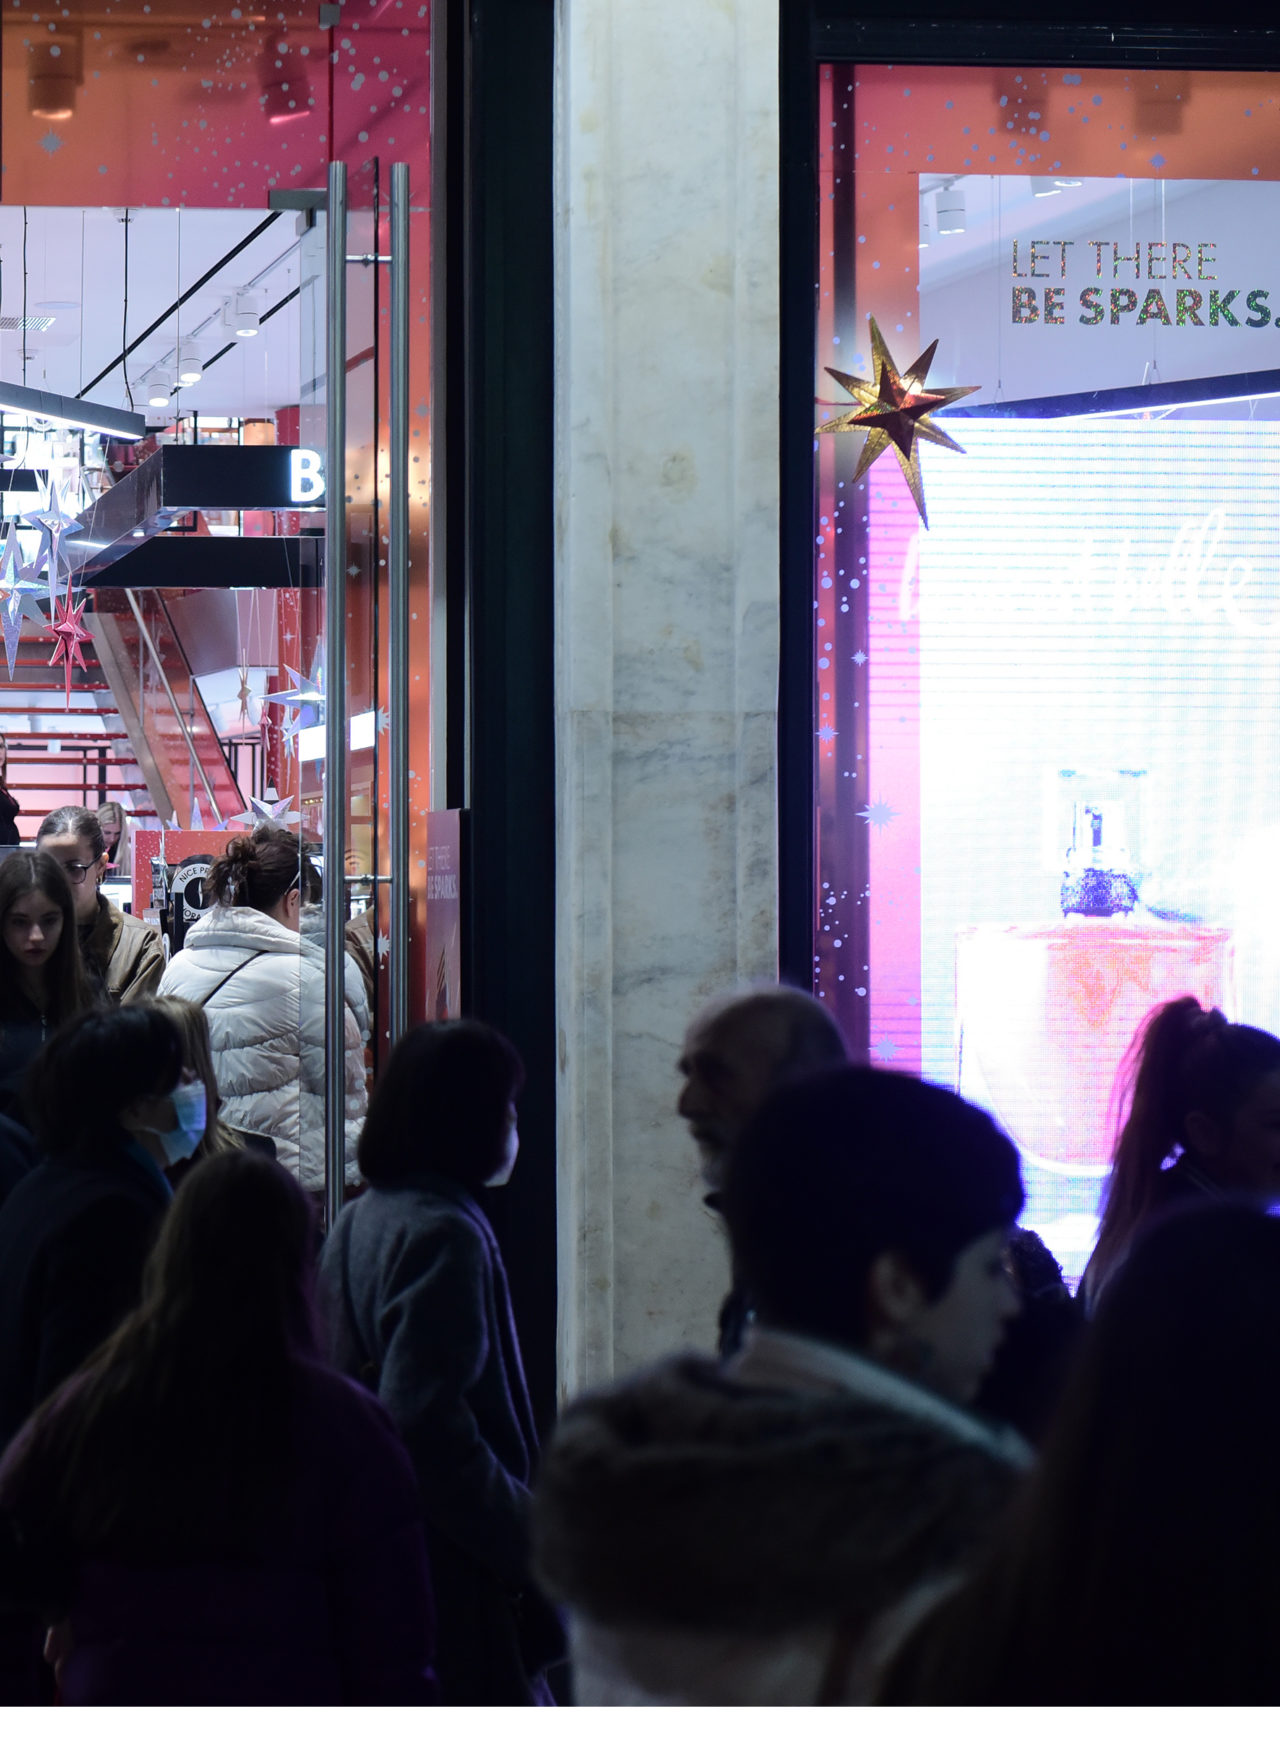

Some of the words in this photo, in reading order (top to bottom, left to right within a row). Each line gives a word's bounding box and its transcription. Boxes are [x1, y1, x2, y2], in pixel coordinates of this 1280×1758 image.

[1011, 239, 1074, 279] LET
[1088, 240, 1217, 280] THERE
[1011, 285, 1065, 324] BE
[178, 866, 198, 883] NICE
